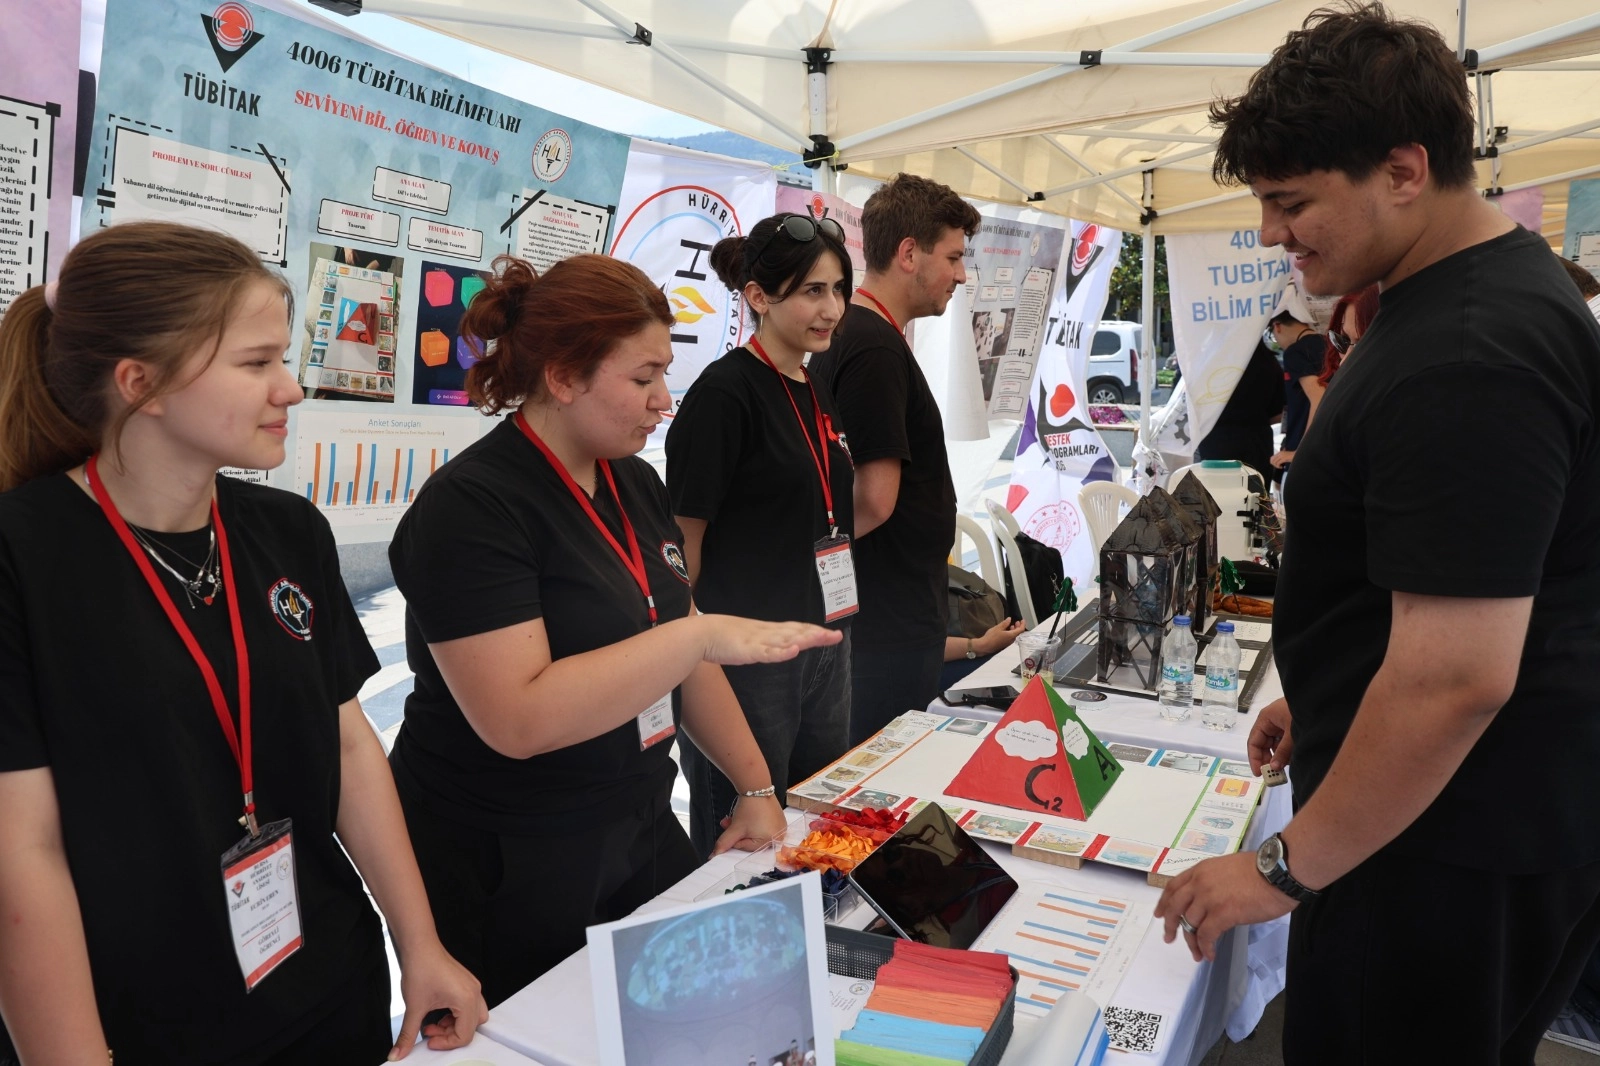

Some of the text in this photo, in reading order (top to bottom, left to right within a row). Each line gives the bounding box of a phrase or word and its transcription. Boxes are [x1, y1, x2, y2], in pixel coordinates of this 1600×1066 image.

[286, 41, 342, 74] 4006
[345, 59, 428, 105] TÜBİTAK
[183, 71, 262, 117] TÜBİTAK
[294, 90, 500, 166] SEVİYENİ BİL, ÖĞREN VE KONUŞ
[152, 150, 252, 180] PROBLEM VE SORU CÜMLESİ
[0, 176, 26, 186] ylerini
[14, 188, 24, 196] bu
[0, 206, 20, 215] kiler
[1192, 294, 1252, 322] BİLİM
[368, 418, 422, 429] Anket Sonuçları
[1050, 444, 1099, 458] OGRAMLARI
[1093, 745, 1116, 781] A
